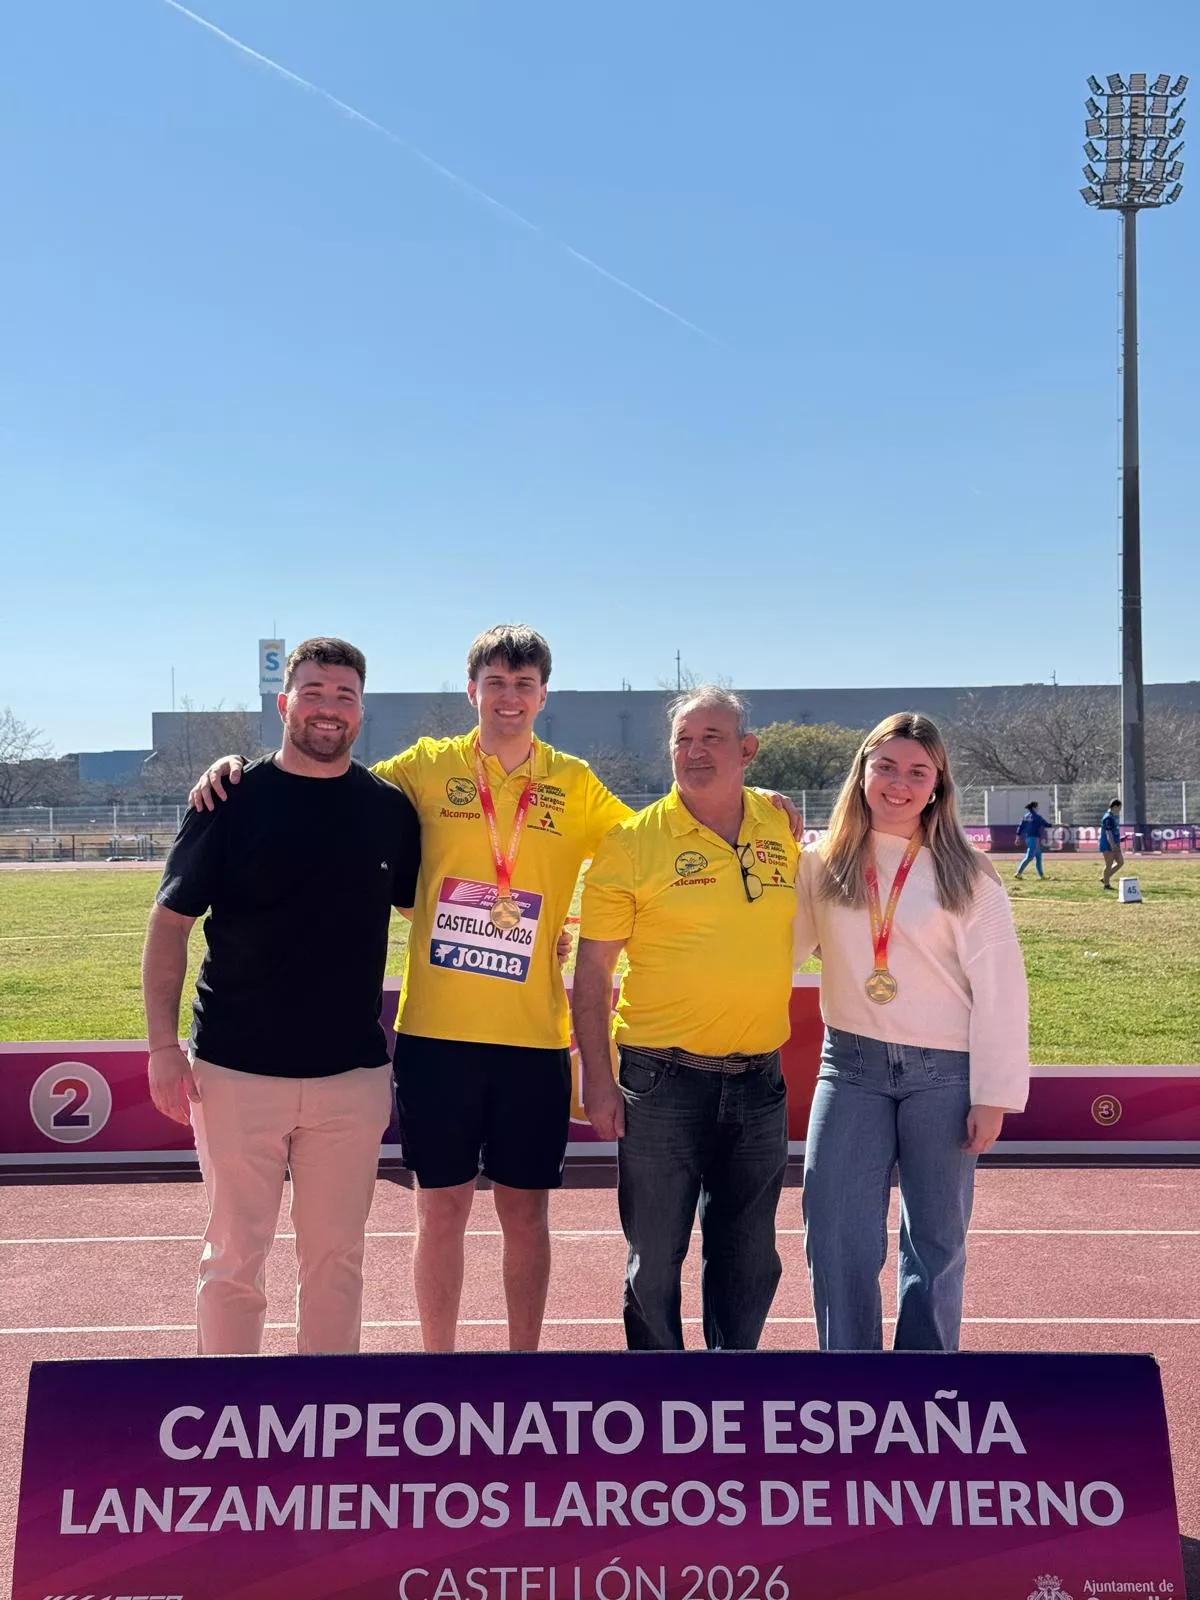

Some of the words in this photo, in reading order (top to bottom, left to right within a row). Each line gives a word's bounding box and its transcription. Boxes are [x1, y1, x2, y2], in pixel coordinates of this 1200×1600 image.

[265, 651, 280, 672] S
[439, 807, 481, 820] Alcampo
[505, 925, 533, 946] 2026
[49, 1076, 92, 1130] 2
[1097, 1100, 1116, 1120] 3
[159, 1400, 645, 1461] CAMPEONATO
[661, 1400, 746, 1454] DE
[762, 1389, 1027, 1454] ESPAÑA
[60, 1481, 510, 1535] LANZAMIENTOS
[524, 1480, 747, 1527] LARGOS
[760, 1480, 832, 1527] DE
[846, 1480, 1124, 1527] INVIERNO
[681, 1565, 790, 1600] 2026
[1083, 1579, 1156, 1595] Ajuntament
[1158, 1579, 1174, 1592] de
